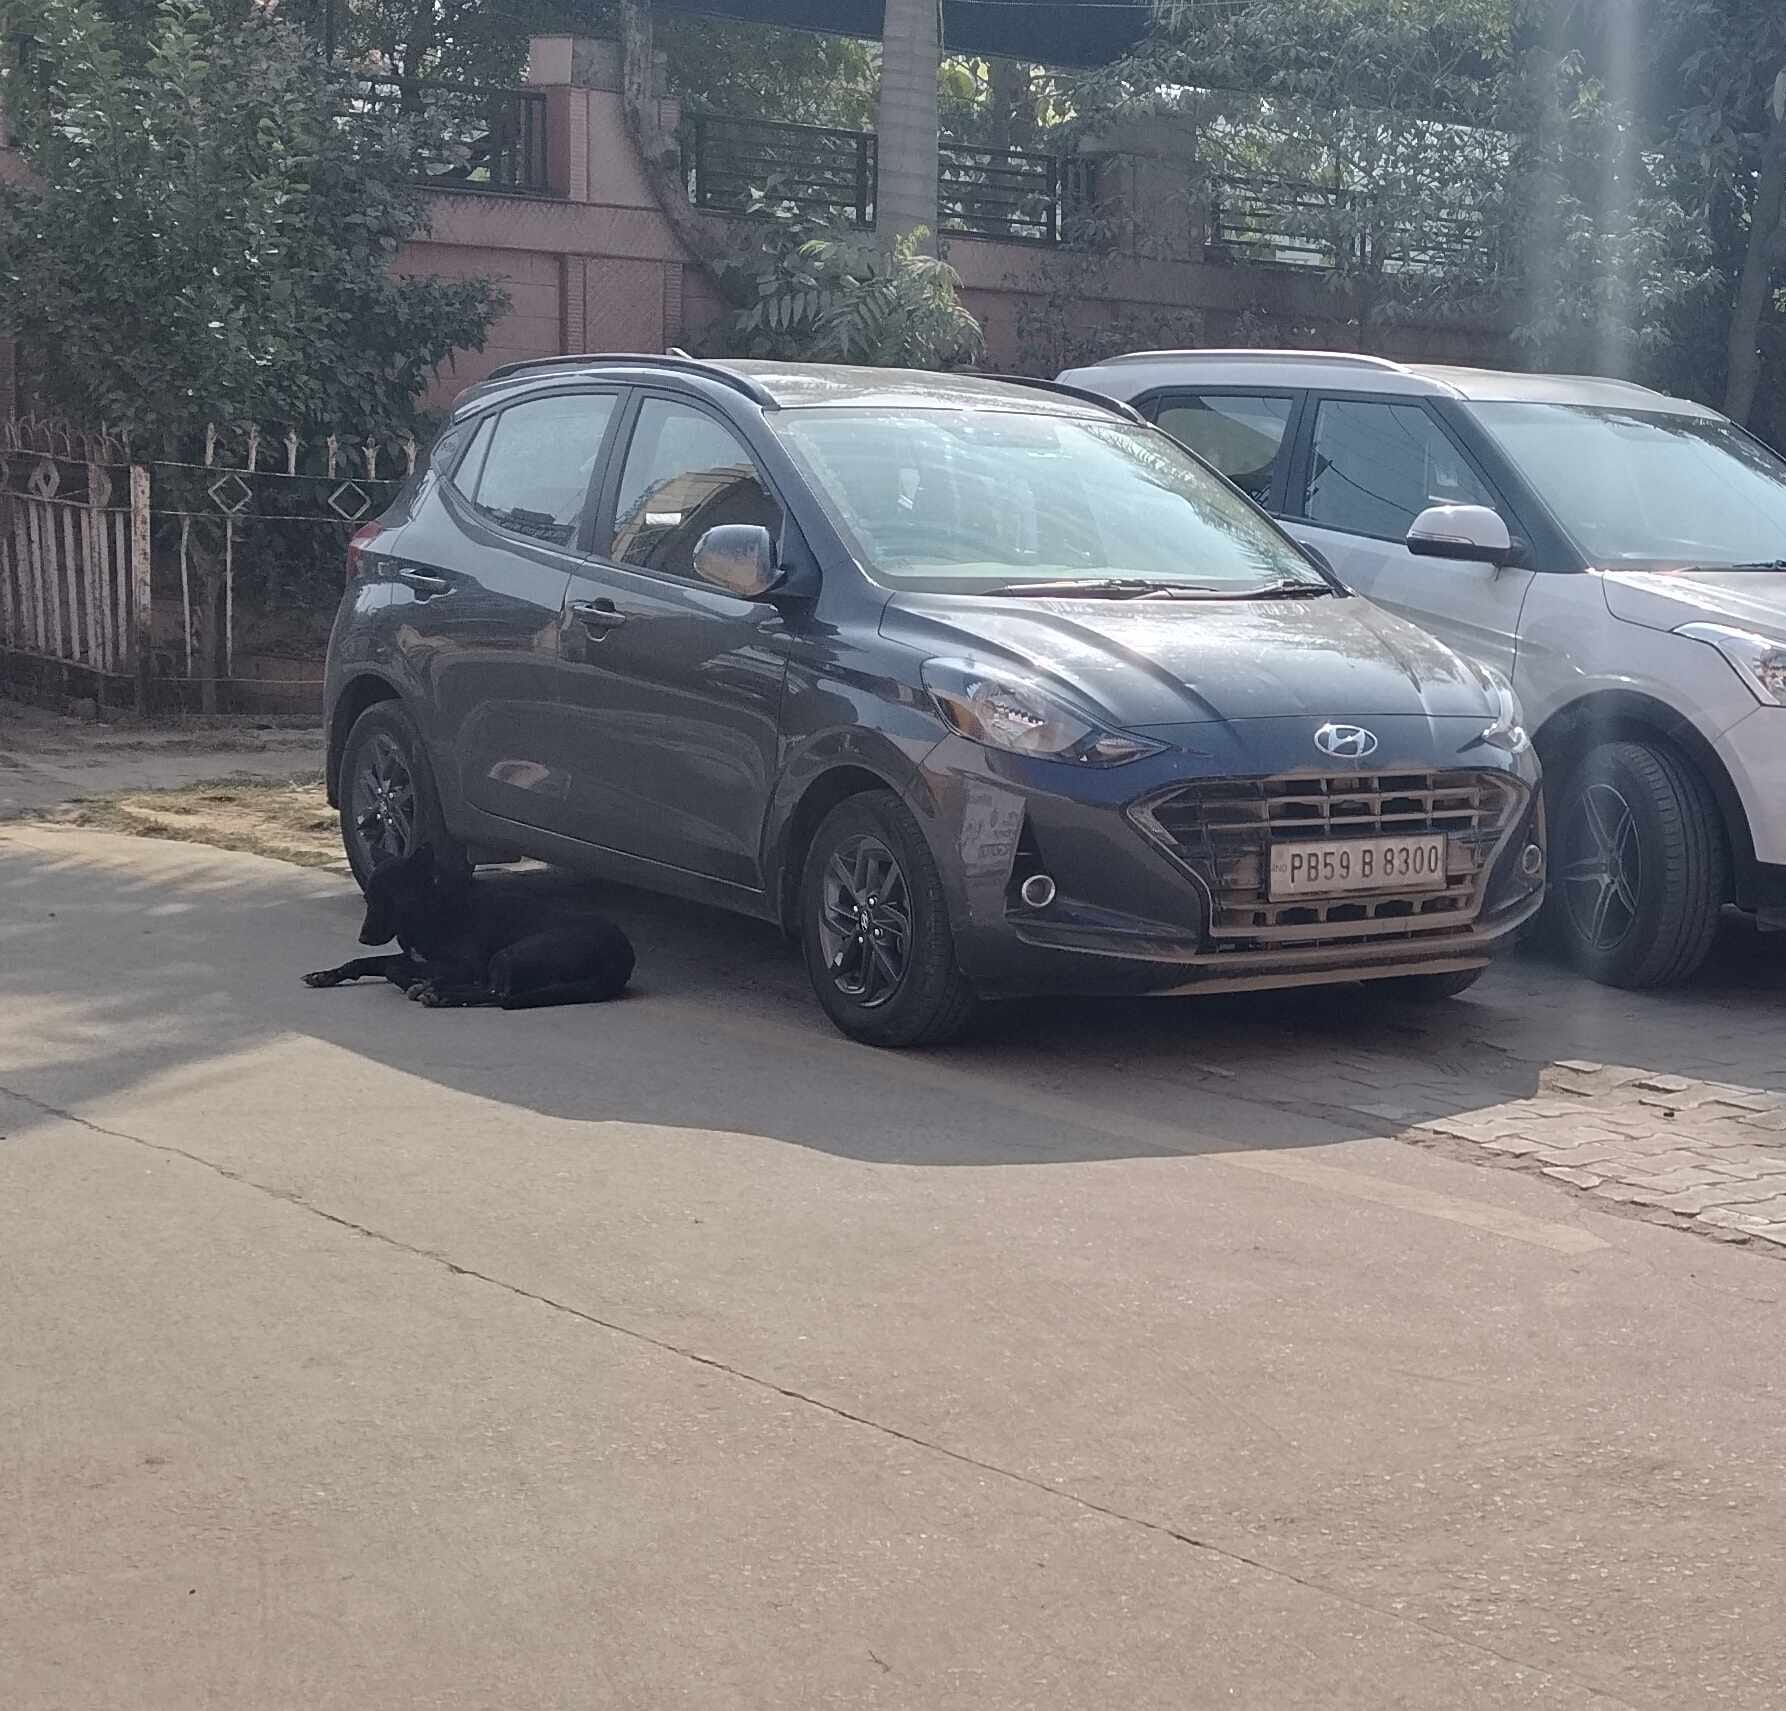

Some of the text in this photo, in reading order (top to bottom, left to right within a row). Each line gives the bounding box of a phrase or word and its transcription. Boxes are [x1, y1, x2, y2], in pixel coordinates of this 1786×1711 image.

[1290, 845, 1439, 884] PB59 B 8300
